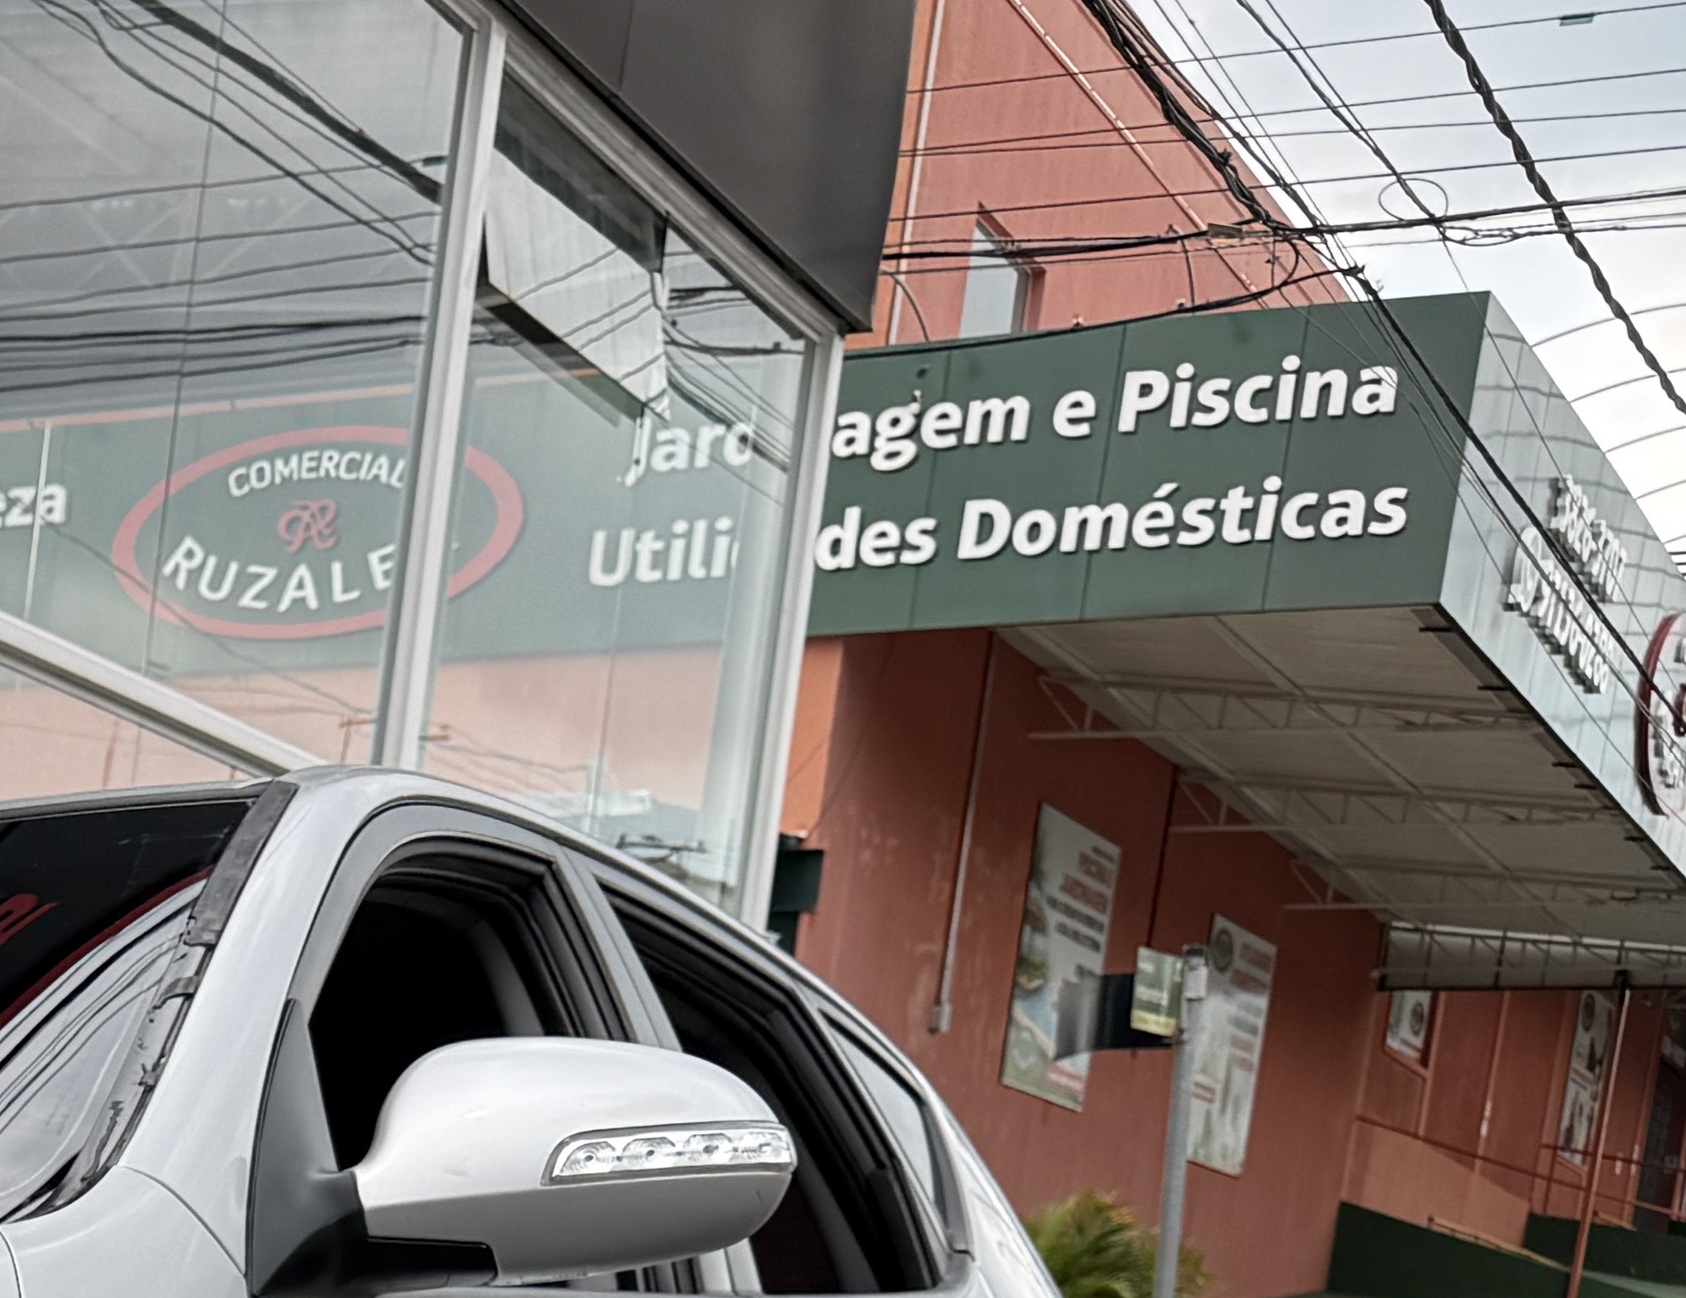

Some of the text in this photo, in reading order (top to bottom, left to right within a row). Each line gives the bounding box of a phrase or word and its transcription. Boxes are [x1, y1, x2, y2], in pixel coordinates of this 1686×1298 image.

[1053, 387, 1100, 440] e
[1117, 355, 1400, 434] Piscina
[228, 449, 406, 497] COMERCIAL
[956, 475, 1410, 561] Domésticas
[162, 535, 459, 613] RUZALE
